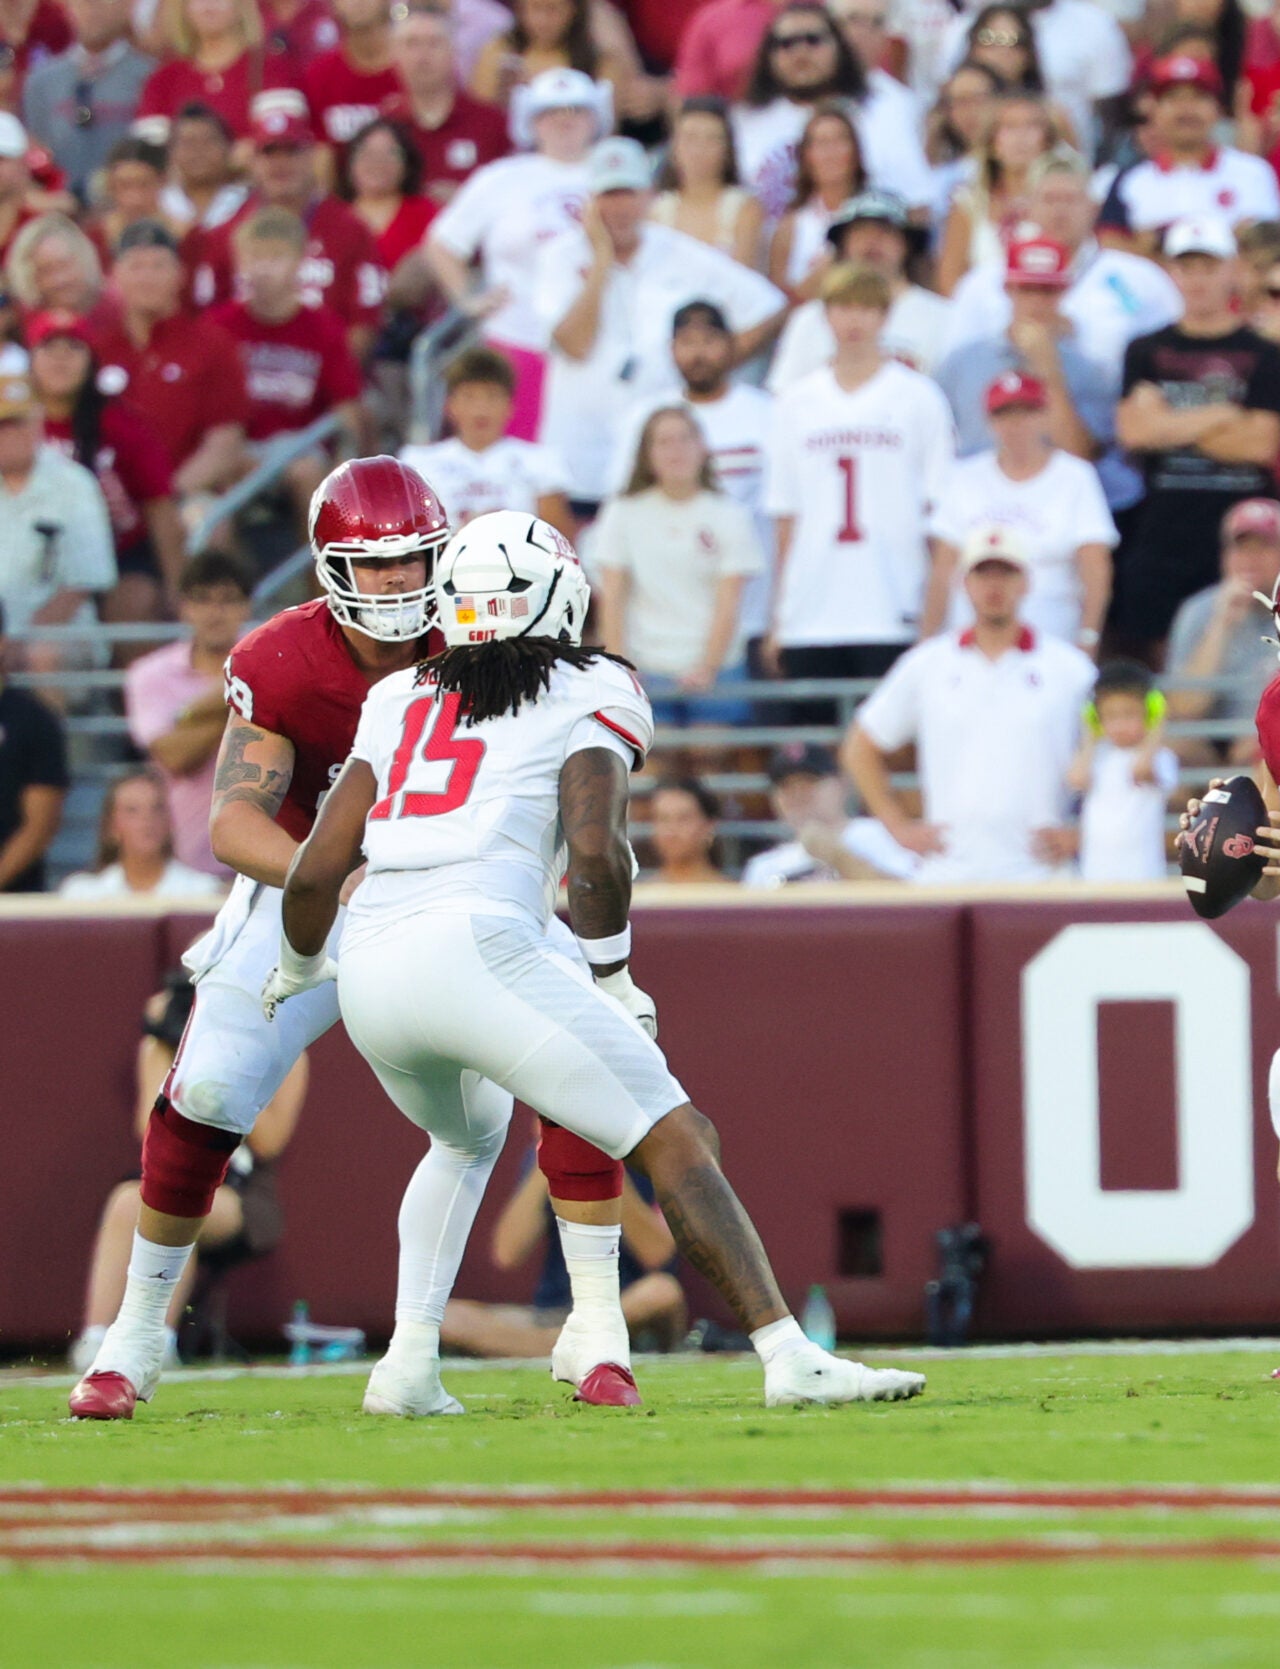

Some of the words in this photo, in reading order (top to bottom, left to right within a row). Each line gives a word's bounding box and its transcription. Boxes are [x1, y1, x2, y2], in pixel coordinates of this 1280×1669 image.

[837, 458, 861, 542] 1
[469, 630, 496, 641] GRIT
[367, 691, 487, 823] 15
